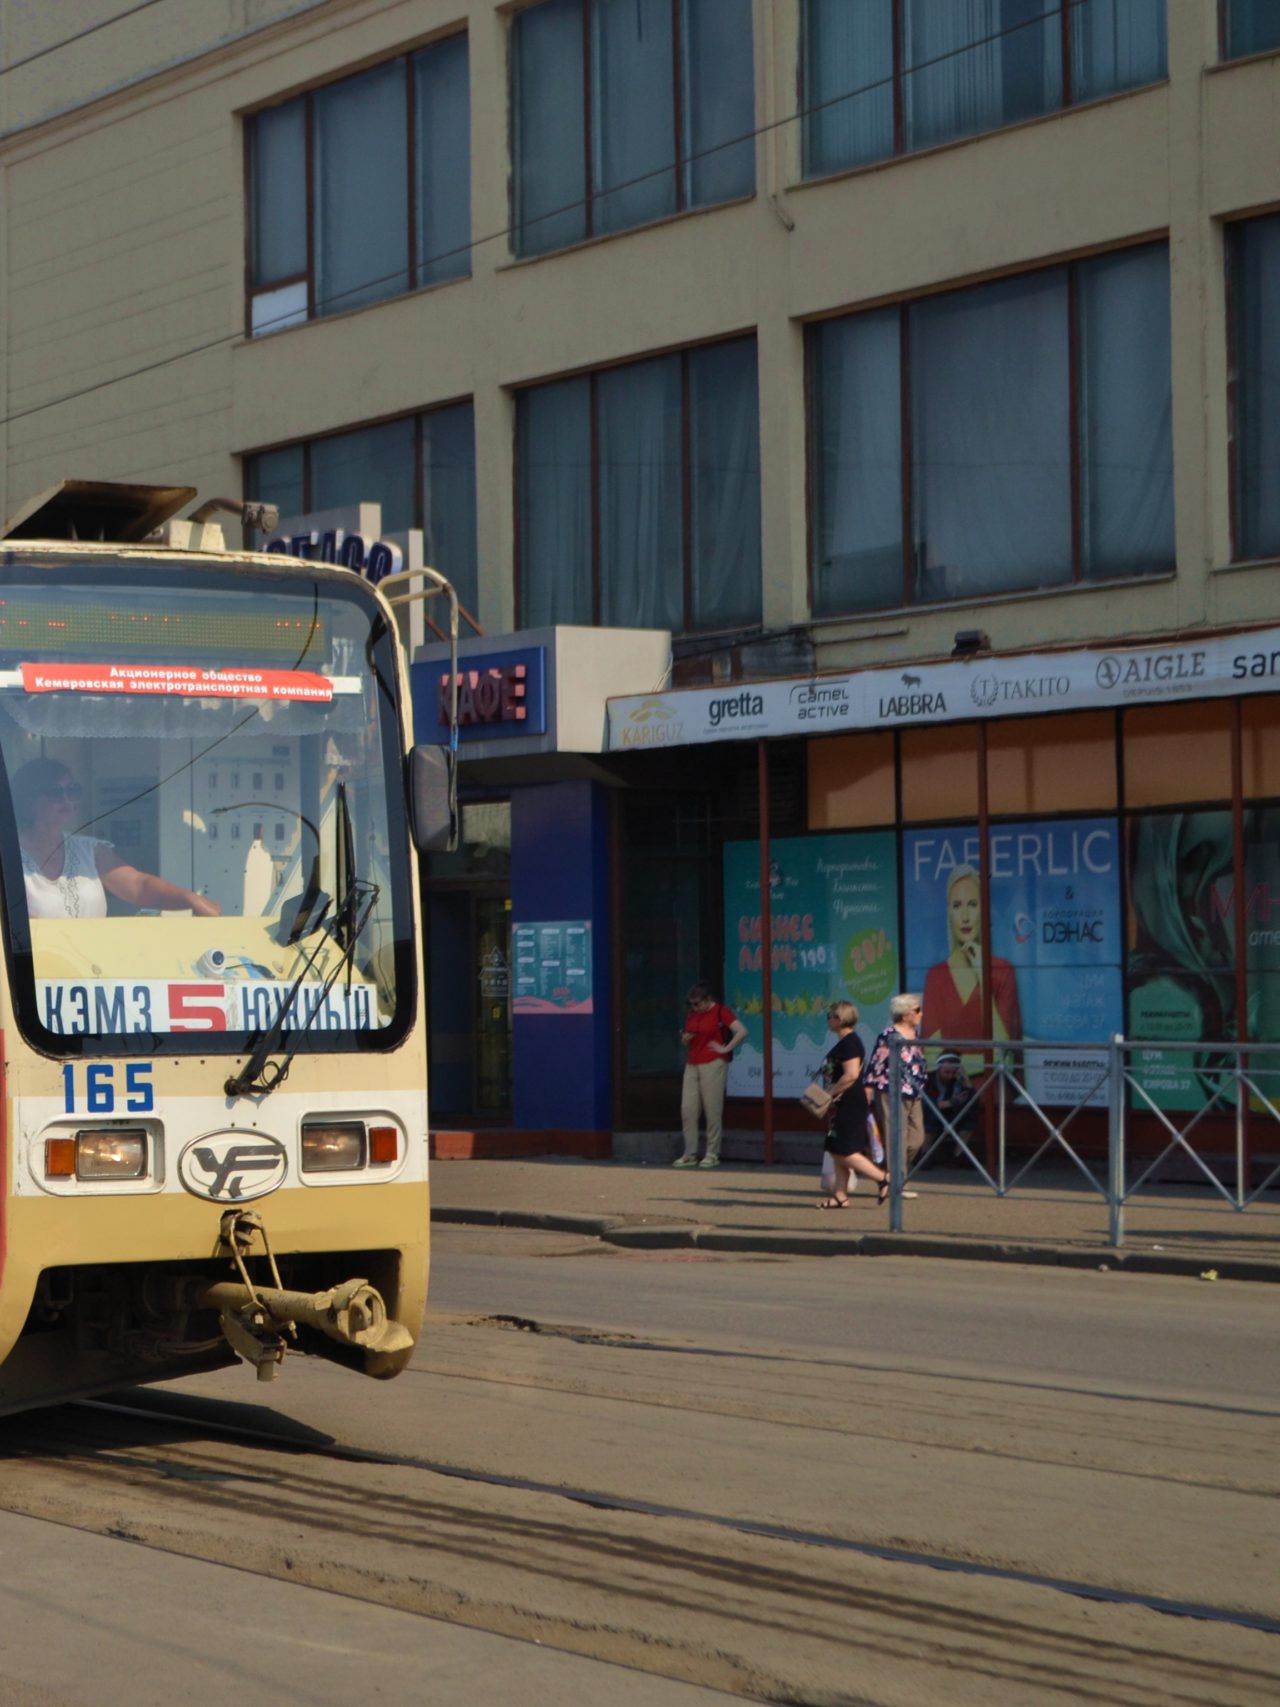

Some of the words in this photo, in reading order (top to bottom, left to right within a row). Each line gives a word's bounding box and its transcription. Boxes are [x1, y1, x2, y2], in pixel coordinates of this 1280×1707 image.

[110, 667, 197, 681] Акционерное
[202, 670, 262, 683] общество
[1122, 651, 1206, 683] AIGLE
[35, 677, 124, 690] Кемеровская
[130, 680, 268, 694] электротранспортная
[798, 688, 849, 704] camel
[1000, 676, 1071, 700] TAKITO
[709, 692, 763, 727] gretta
[798, 704, 849, 720] active
[879, 693, 946, 719] LABBRA
[623, 722, 685, 746] KARIGUZ
[1065, 885, 1075, 900] &
[739, 914, 814, 943] БИНЕС
[45, 984, 152, 1034] КЭМЗ
[167, 984, 226, 1032] 5
[242, 985, 370, 1031] ЮЖНЫЙ
[63, 1063, 154, 1114] 165
